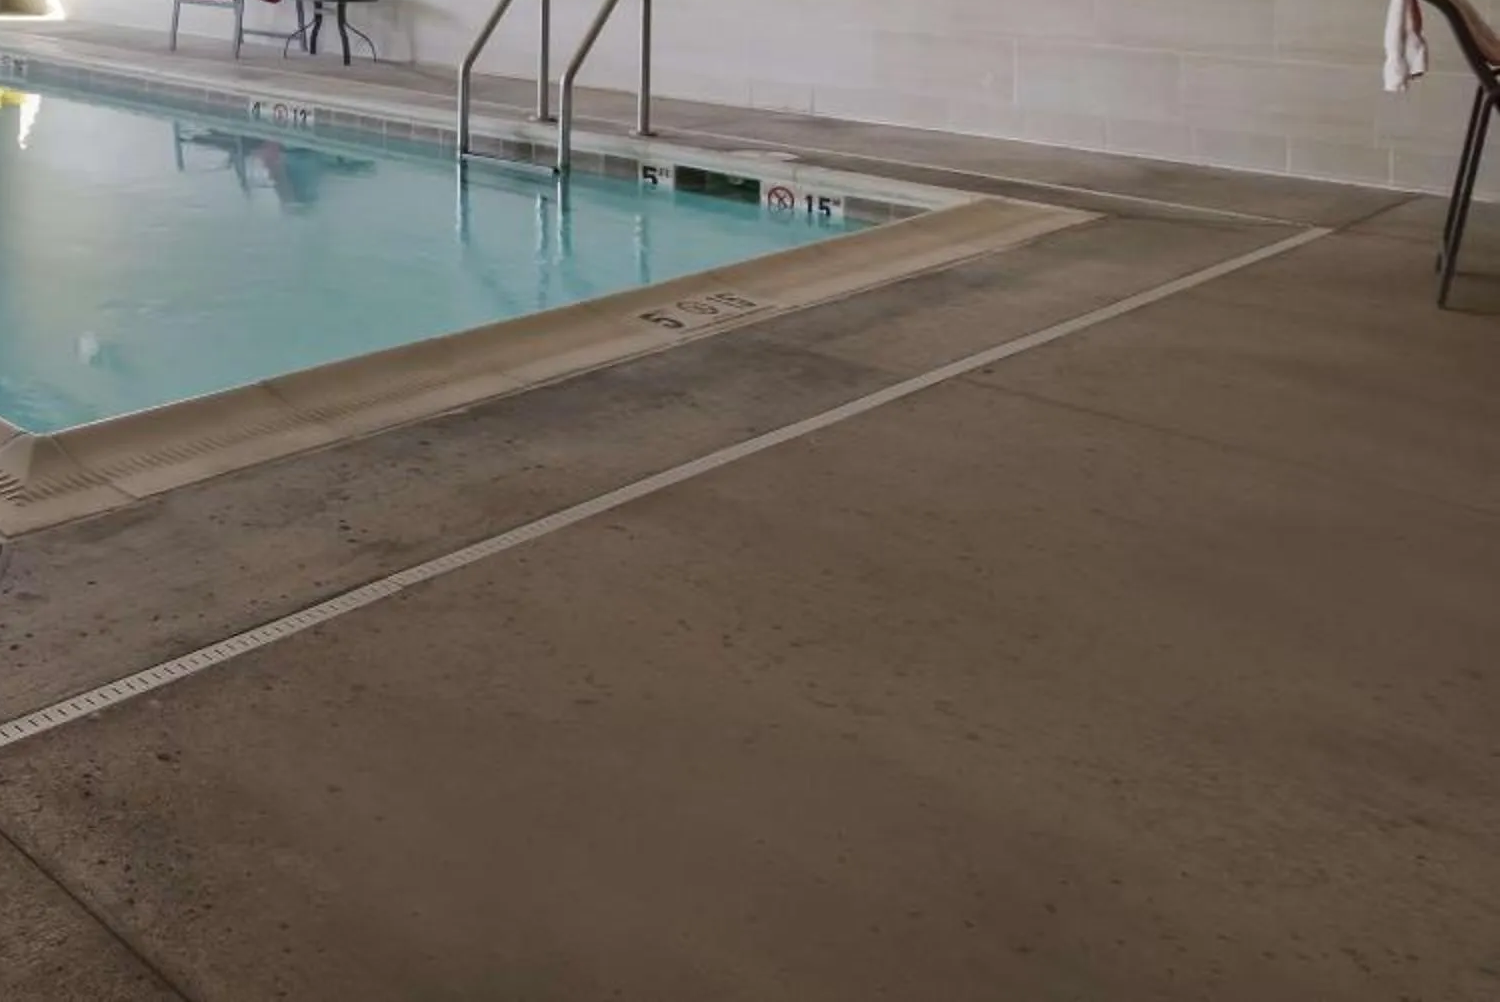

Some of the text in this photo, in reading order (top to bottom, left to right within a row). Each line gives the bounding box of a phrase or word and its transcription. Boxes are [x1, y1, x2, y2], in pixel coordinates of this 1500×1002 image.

[642, 165, 658, 186] 5
[805, 194, 832, 217] 15
[639, 309, 685, 329] 5
